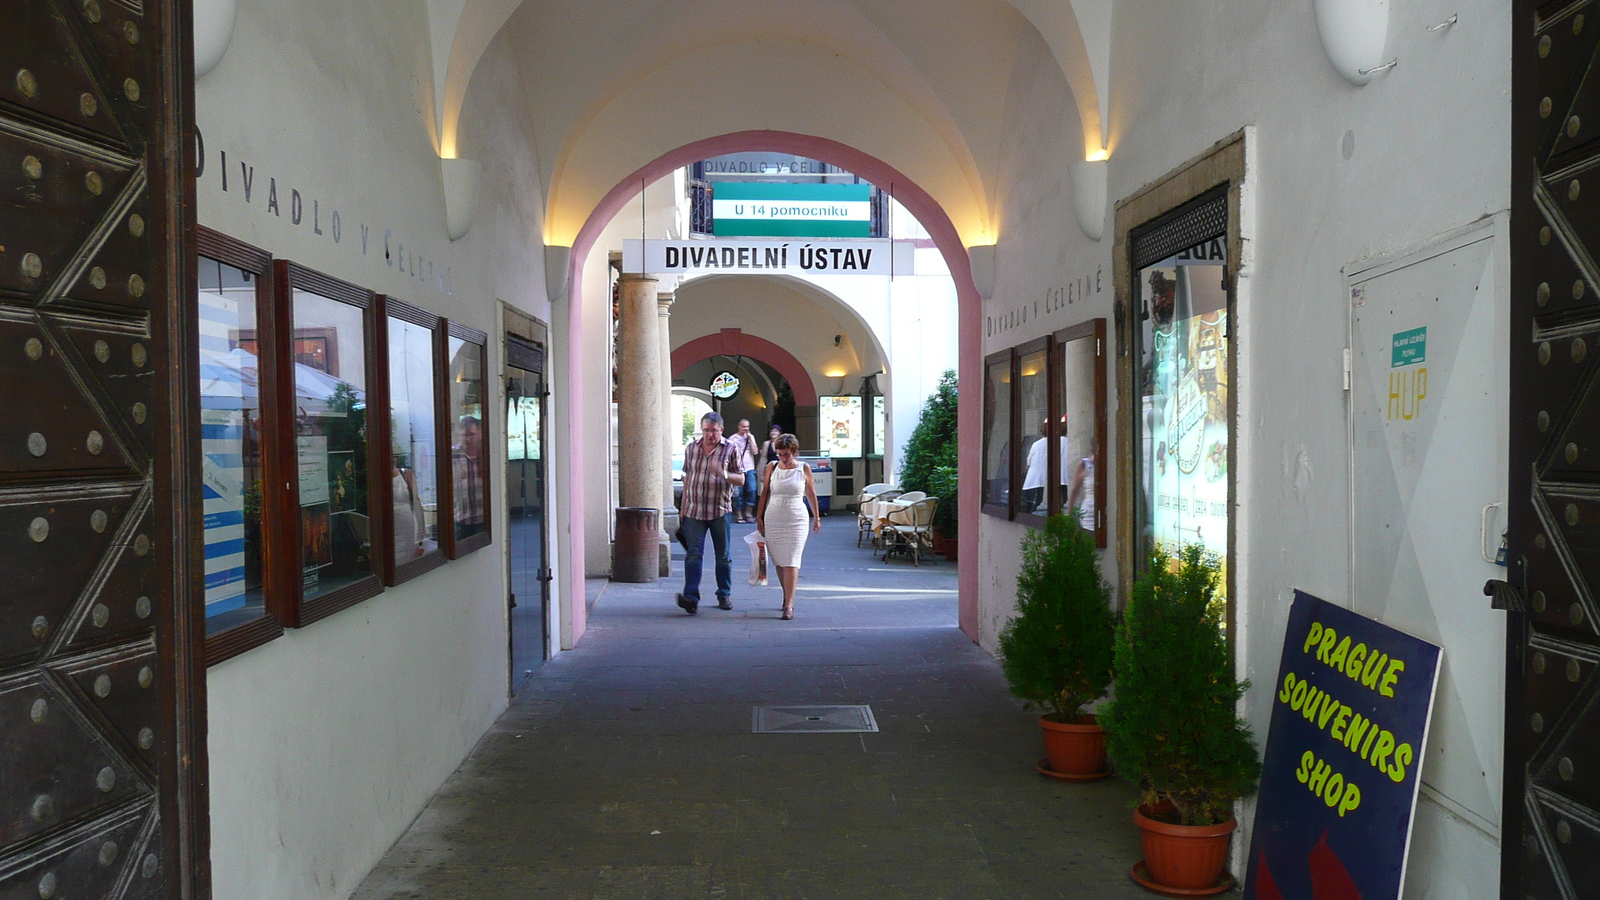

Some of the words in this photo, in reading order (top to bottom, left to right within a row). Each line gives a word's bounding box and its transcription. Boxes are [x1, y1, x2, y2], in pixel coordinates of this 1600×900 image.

[195, 124, 342, 244] DIVADLO
[361, 225, 368, 256] V
[704, 161, 768, 174] DIVADLO
[775, 161, 785, 174] V
[734, 204, 744, 215] U
[751, 204, 765, 216] 14
[665, 243, 790, 269] DIVADELNÍ
[799, 243, 872, 270] ÚSTAV
[987, 305, 1028, 338] DIVADLO
[1033, 300, 1039, 319] V
[1046, 264, 1102, 314] CELETNÉ
[1388, 367, 1428, 420] HUP
[1303, 621, 1405, 699] PRAGUE
[1278, 671, 1413, 784] SOUVENIRS
[1295, 749, 1362, 818] SHOP
